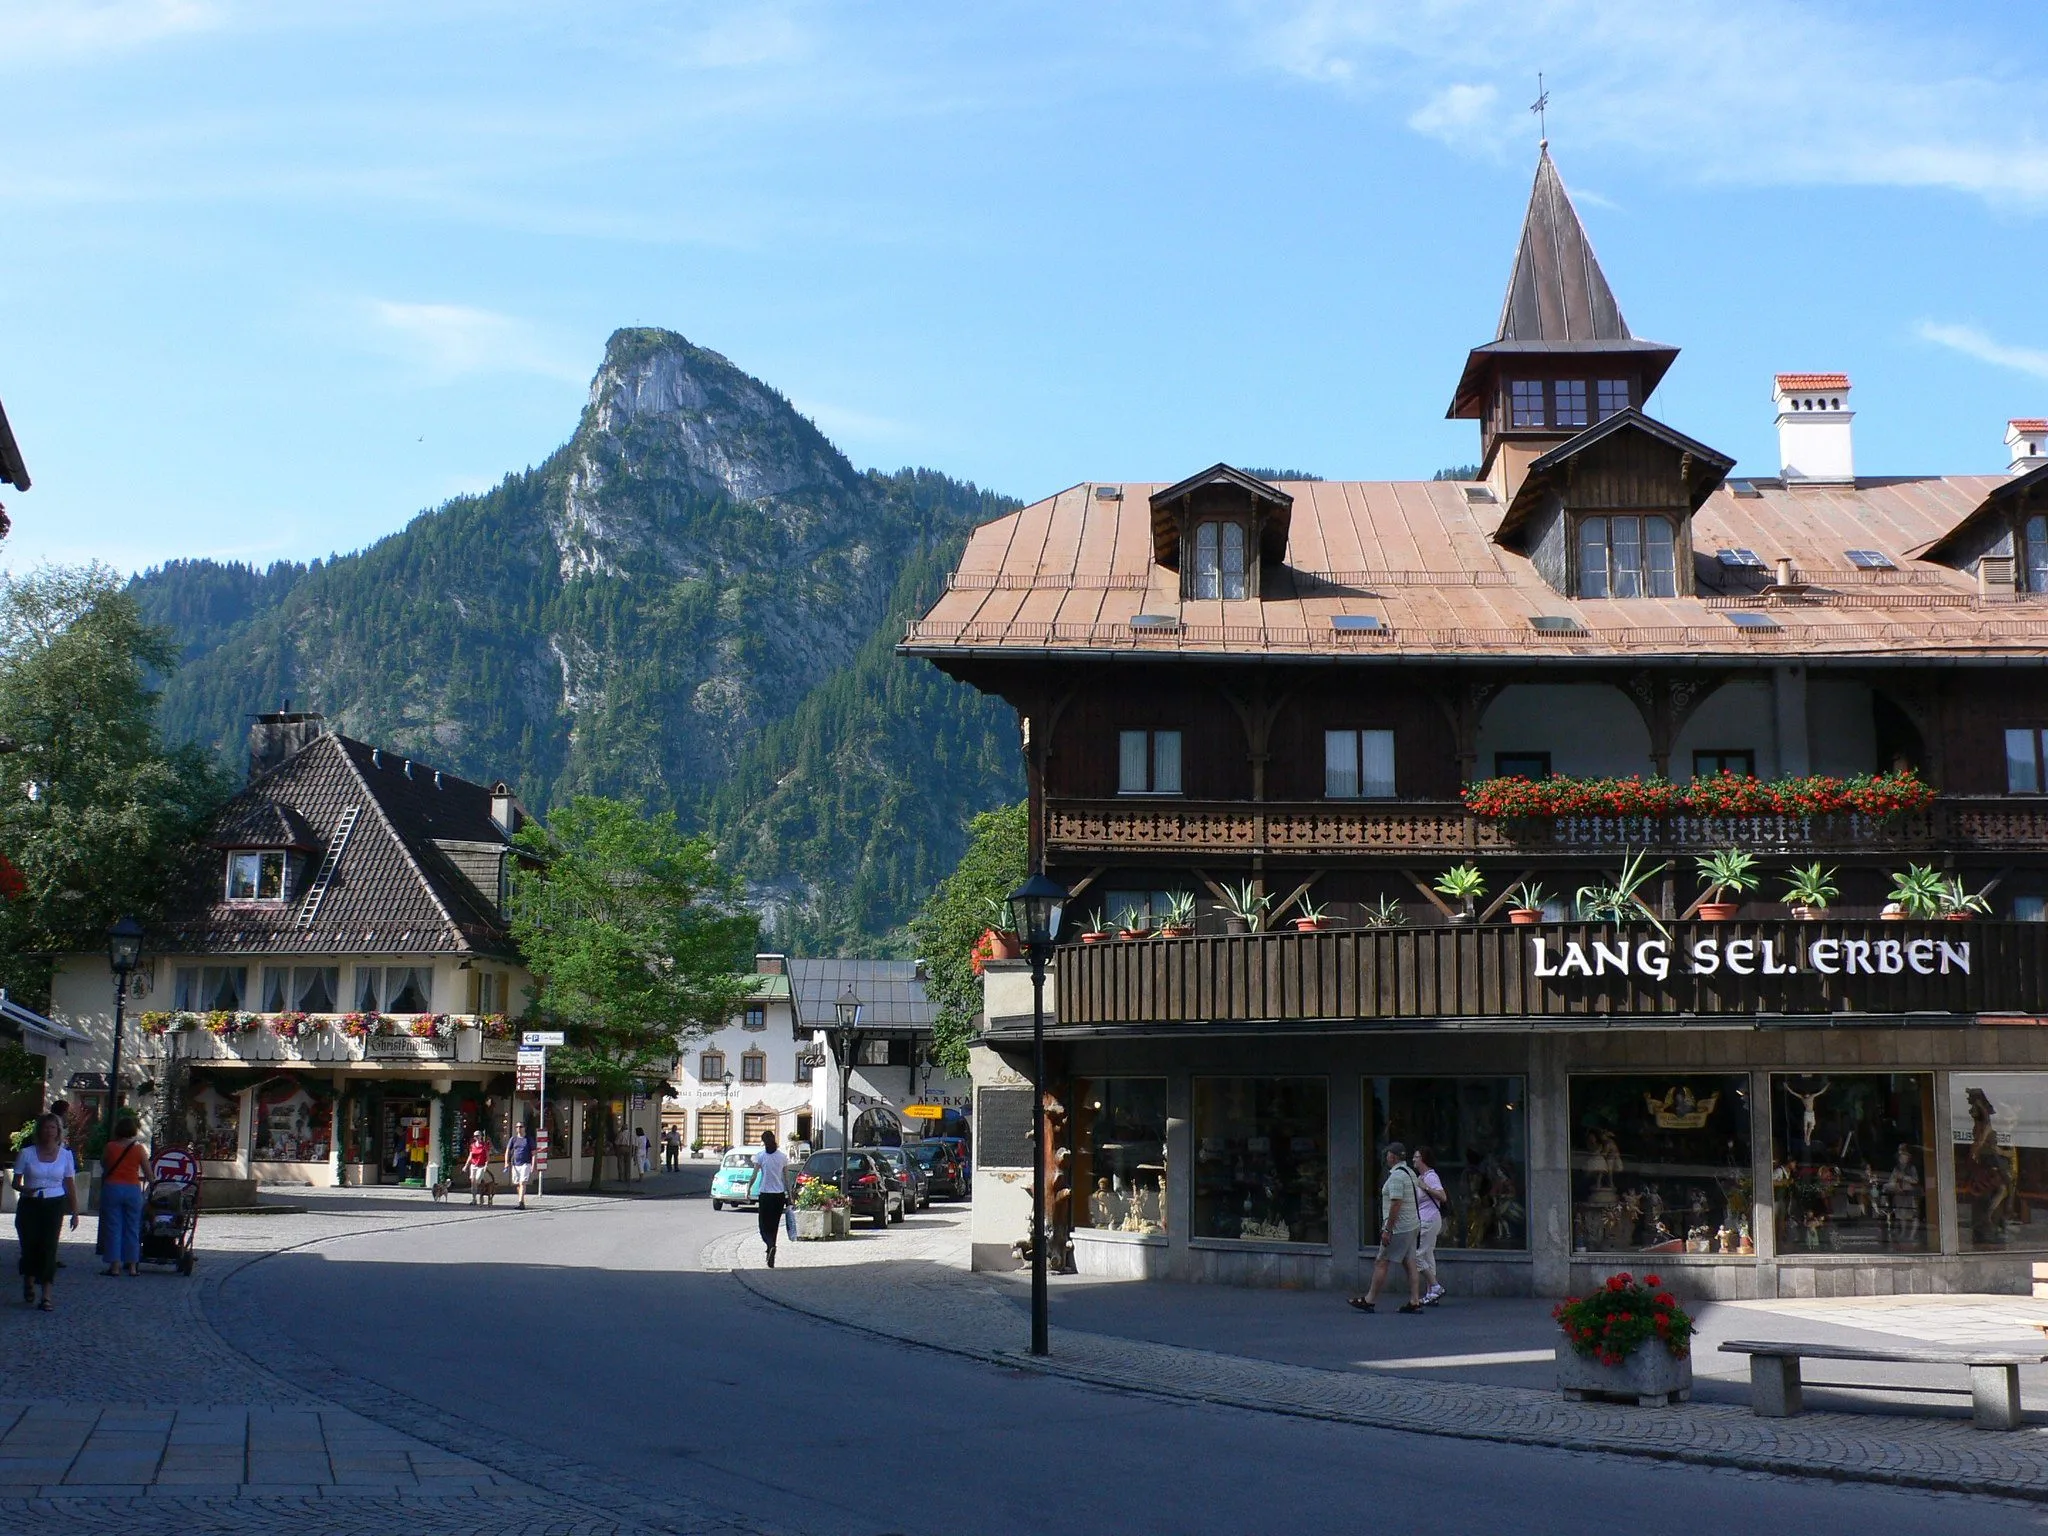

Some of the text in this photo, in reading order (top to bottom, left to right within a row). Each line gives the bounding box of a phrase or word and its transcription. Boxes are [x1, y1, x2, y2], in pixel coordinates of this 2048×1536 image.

[1532, 937, 1971, 981] LANG SEL. ERBEN
